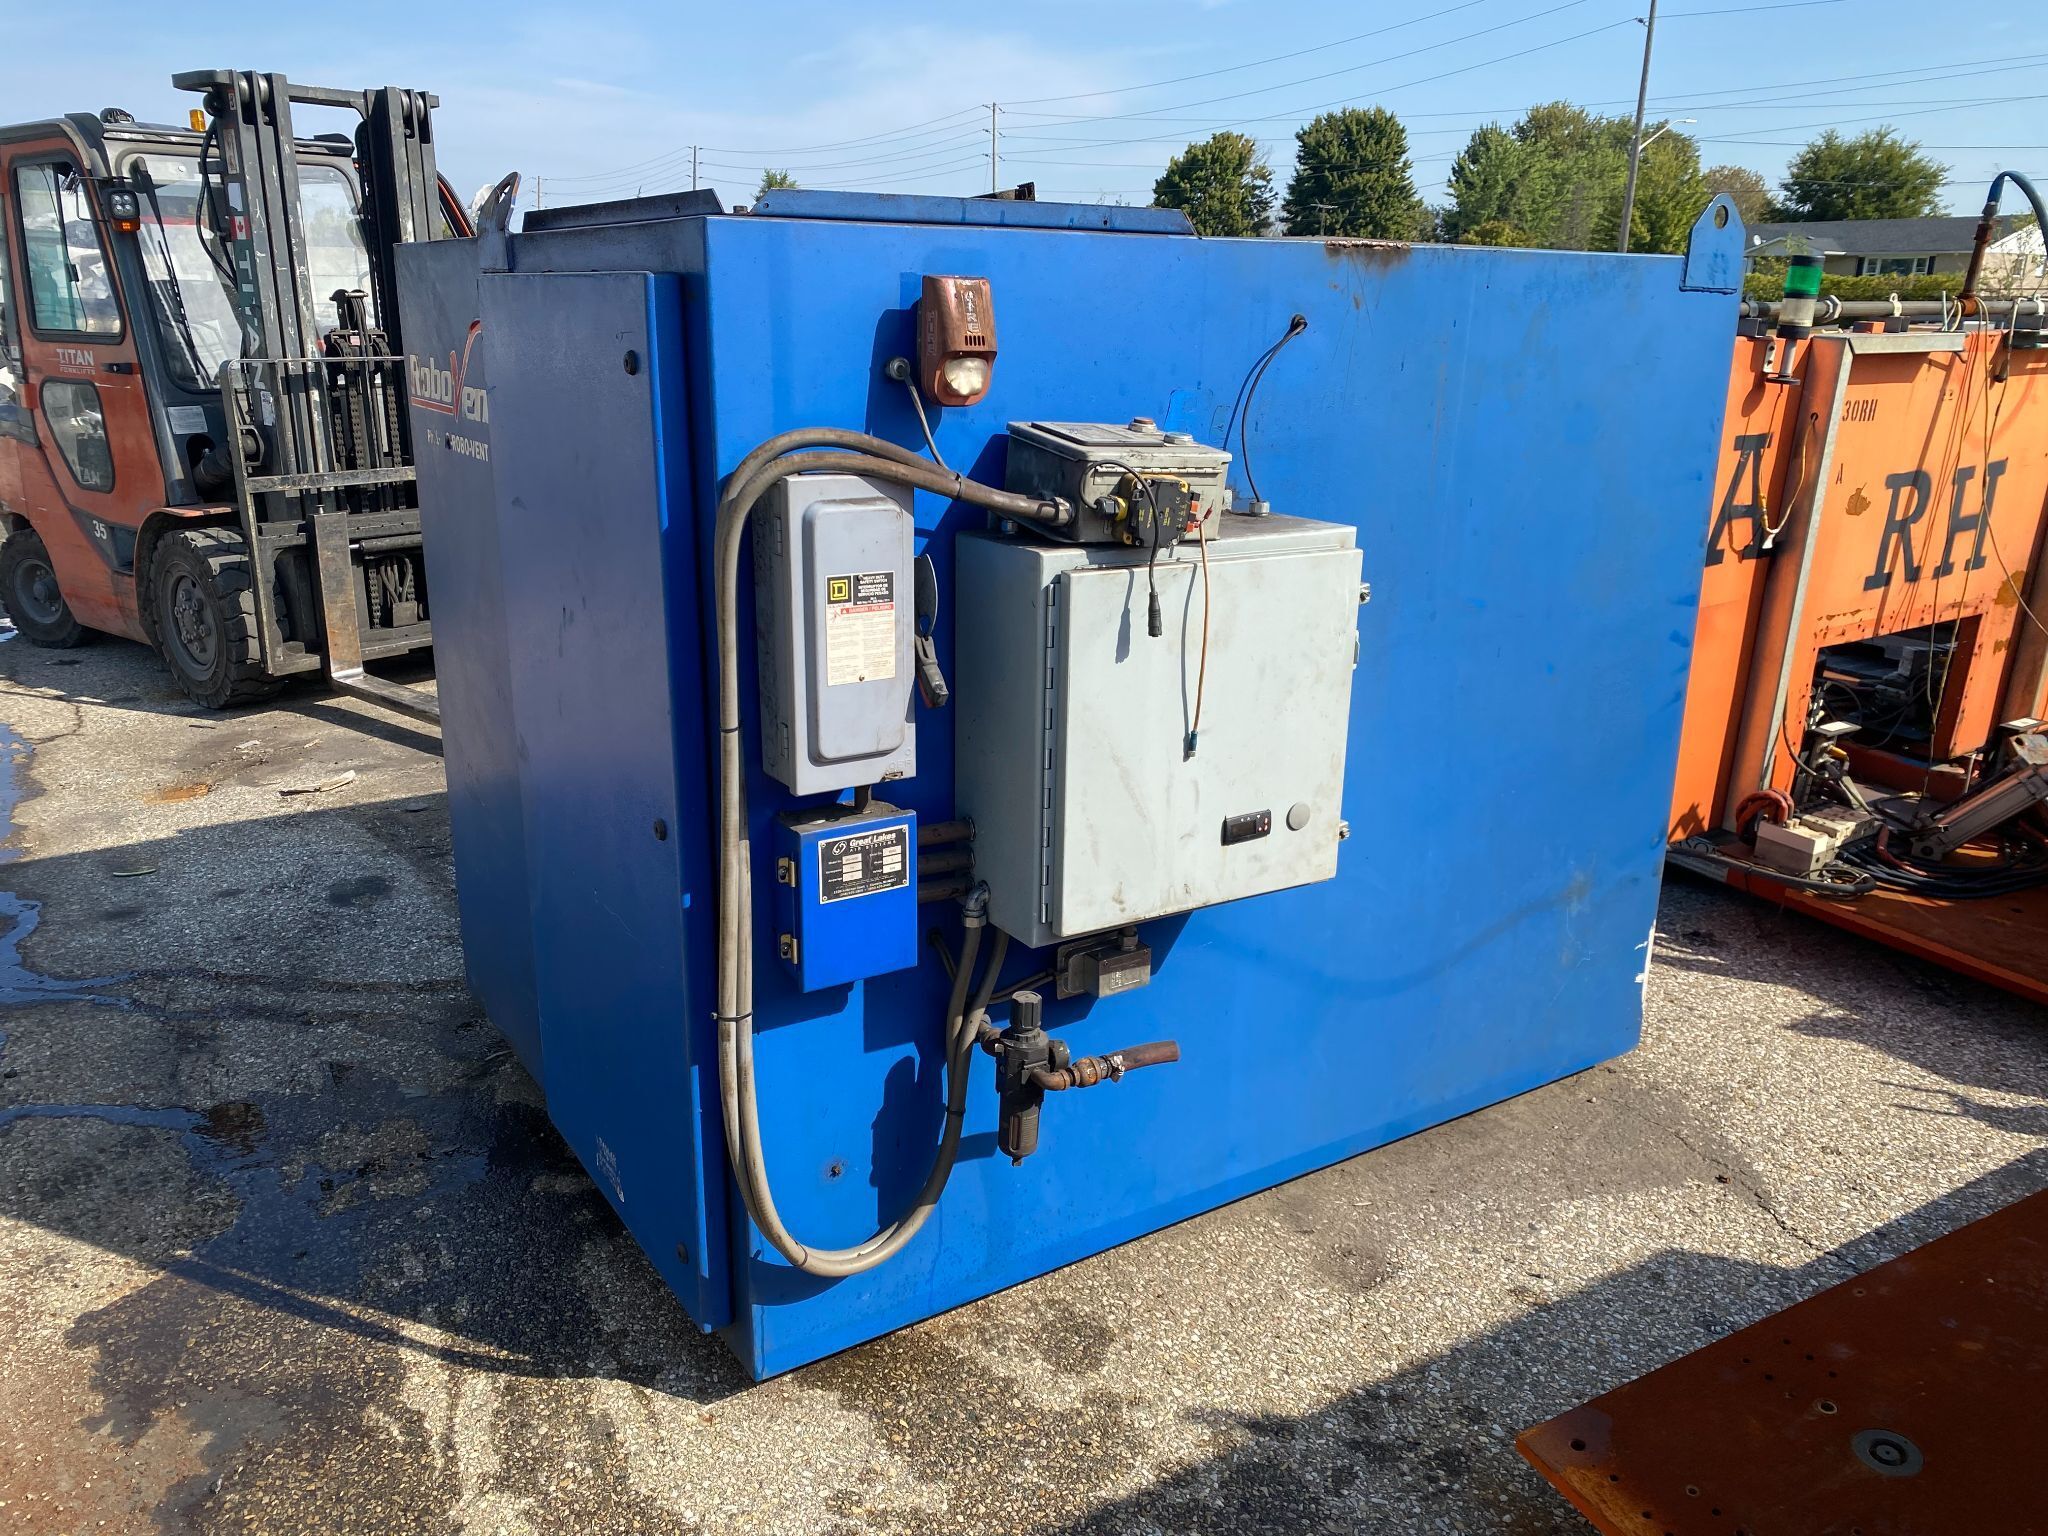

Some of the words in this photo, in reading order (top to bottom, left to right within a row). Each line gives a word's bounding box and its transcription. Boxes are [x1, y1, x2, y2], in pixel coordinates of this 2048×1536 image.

[56, 349, 95, 366] TITAN
[92, 519, 107, 540] 35
[1863, 458, 2010, 592] RH
[849, 835, 872, 847] Great
[874, 832, 896, 842] Lakes
